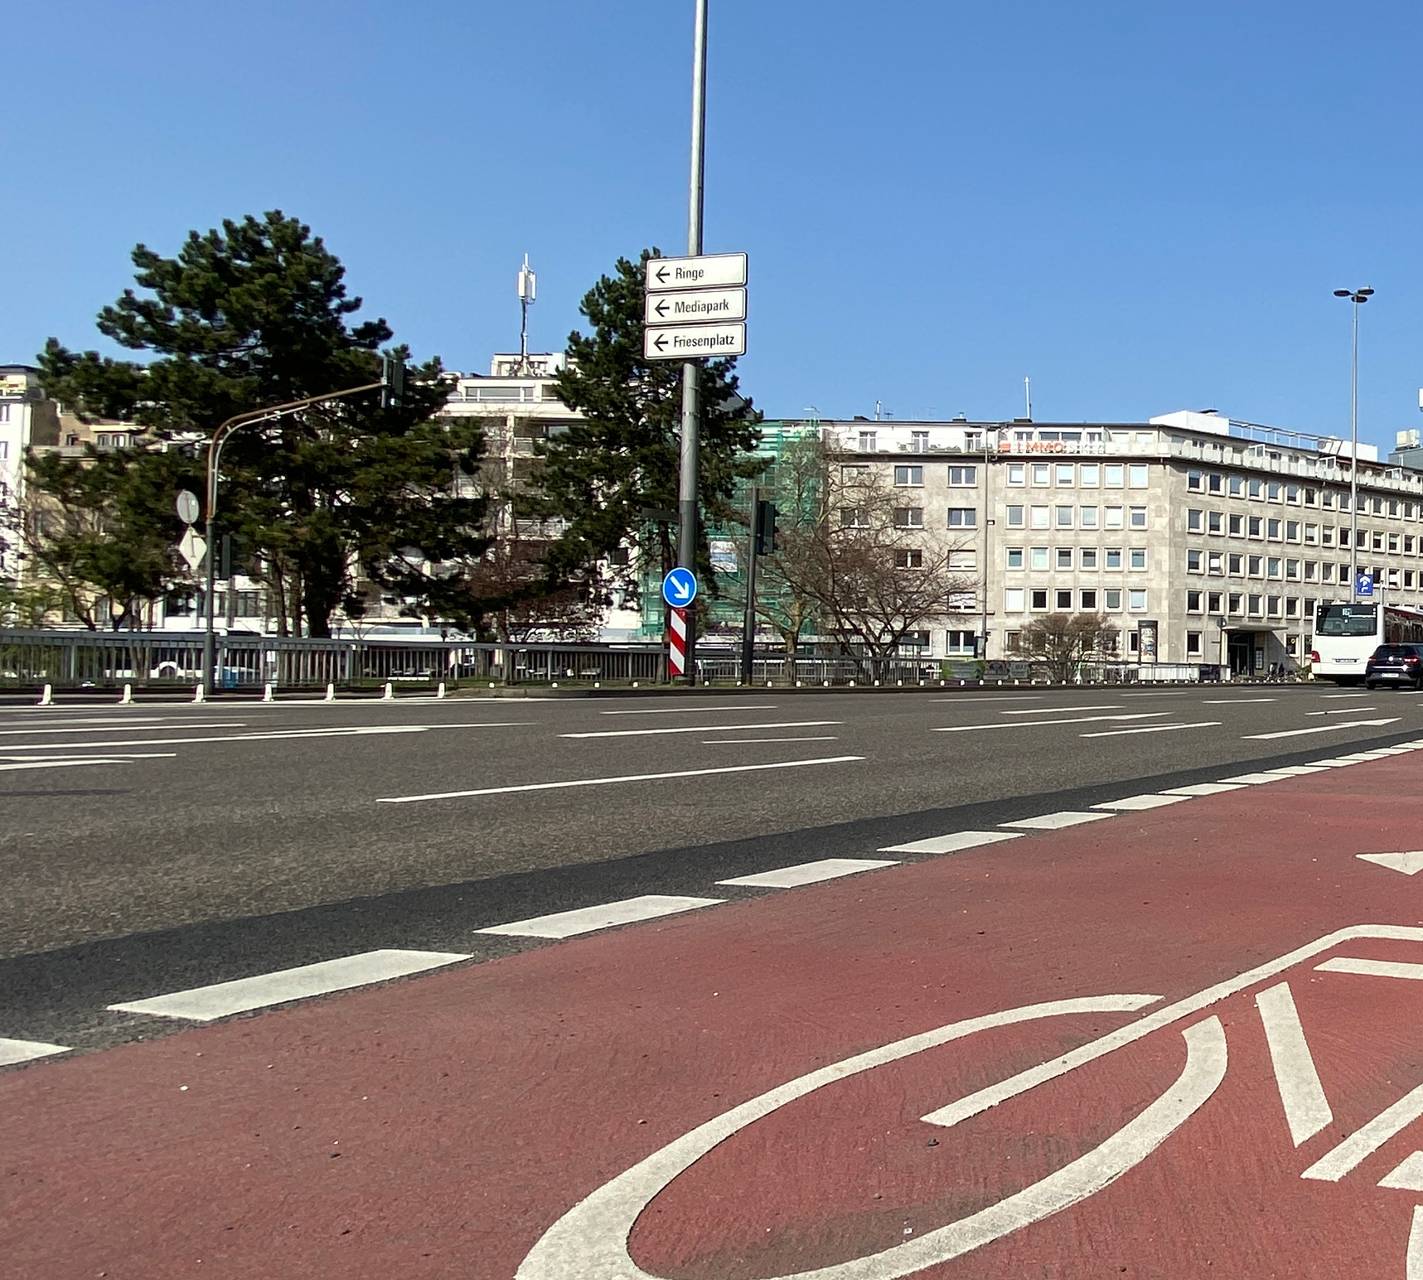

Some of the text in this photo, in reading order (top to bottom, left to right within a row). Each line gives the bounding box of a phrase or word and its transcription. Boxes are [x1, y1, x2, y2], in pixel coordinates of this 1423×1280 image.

[675, 267, 705, 281] Ringe
[674, 299, 730, 314] Mediapark
[673, 333, 735, 348] Friesenplatz
